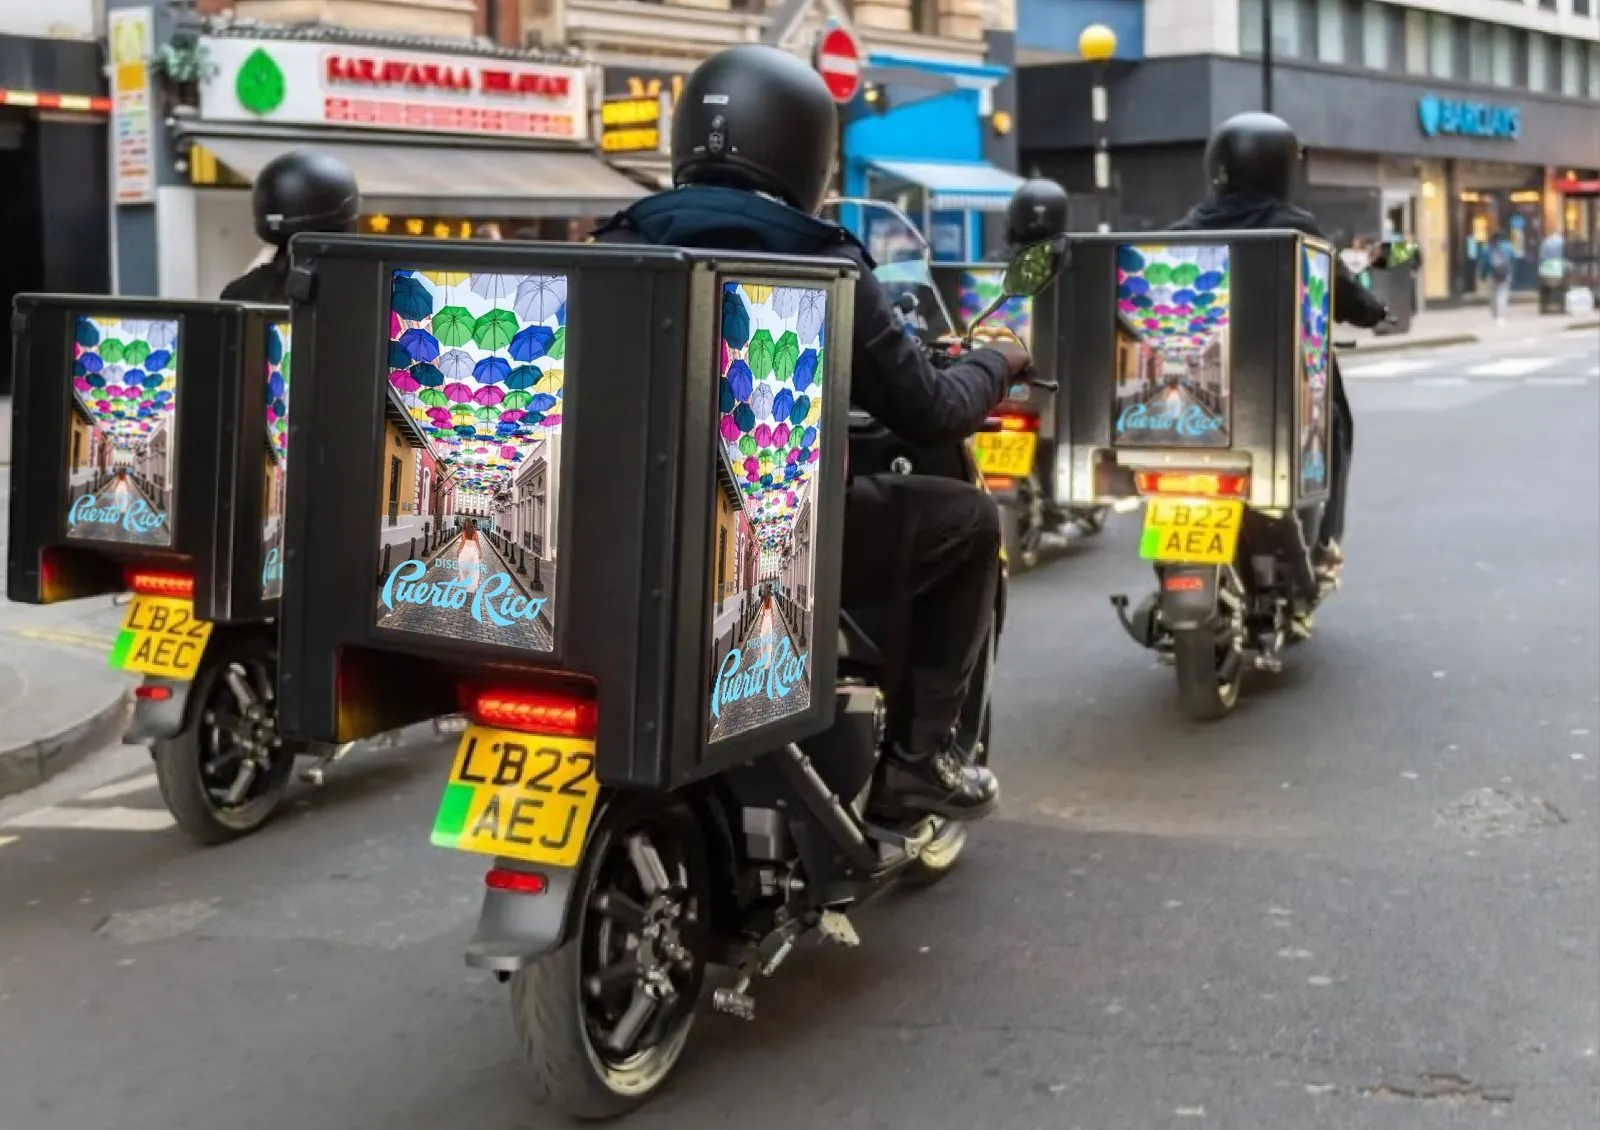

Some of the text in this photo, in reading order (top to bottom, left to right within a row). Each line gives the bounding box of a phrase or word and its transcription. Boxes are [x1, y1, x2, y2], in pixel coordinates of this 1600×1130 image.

[68, 494, 168, 533] Puerto Rico
[1150, 504, 1233, 529] LB22
[1165, 530, 1224, 554] AEA
[381, 559, 548, 627] Puerto Rico
[127, 602, 207, 639] LB22
[133, 636, 196, 668] AEC
[711, 635, 809, 720] Puerto Rico
[458, 736, 594, 798] LB22
[471, 793, 578, 849] AEJ
